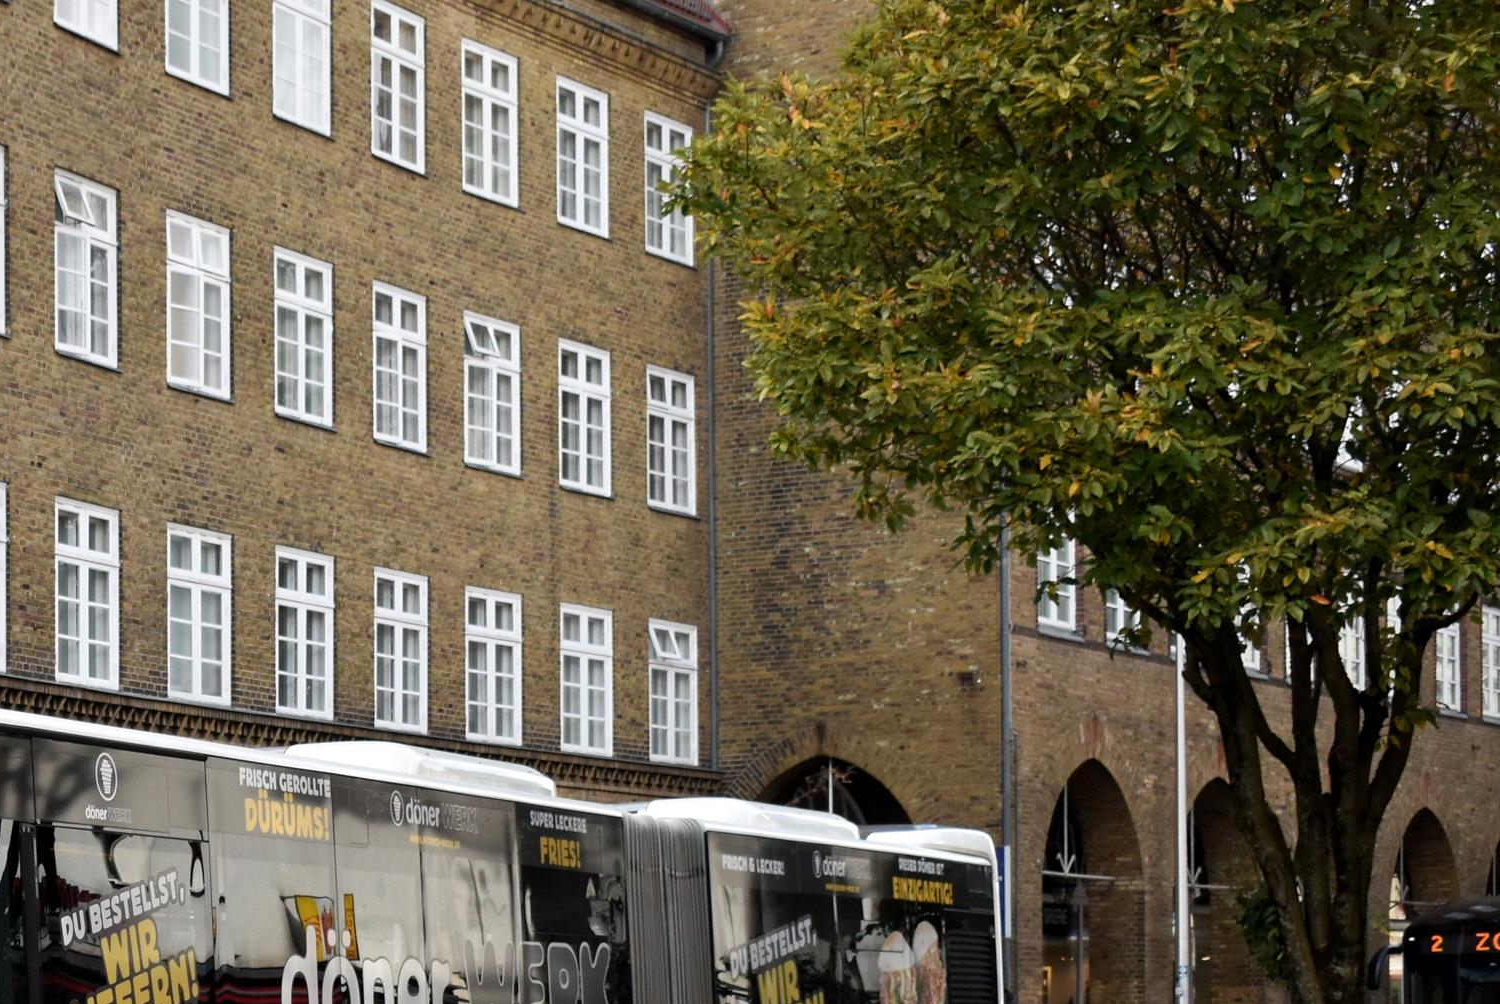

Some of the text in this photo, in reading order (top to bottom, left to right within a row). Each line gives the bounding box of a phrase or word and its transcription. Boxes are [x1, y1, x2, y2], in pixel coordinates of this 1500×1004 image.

[239, 767, 331, 798] FRISCH GEROLLTE
[244, 788, 330, 840] DÜRÜMS!
[529, 810, 587, 834] SUPER LECKERE
[540, 836, 581, 869] FRIES!
[892, 876, 954, 905] EINZIGARTIG!
[61, 871, 185, 946] DU BESTELLST,
[101, 918, 160, 985] WIR
[730, 918, 817, 980] DU BESTELLST,
[1431, 935, 1443, 952] 2
